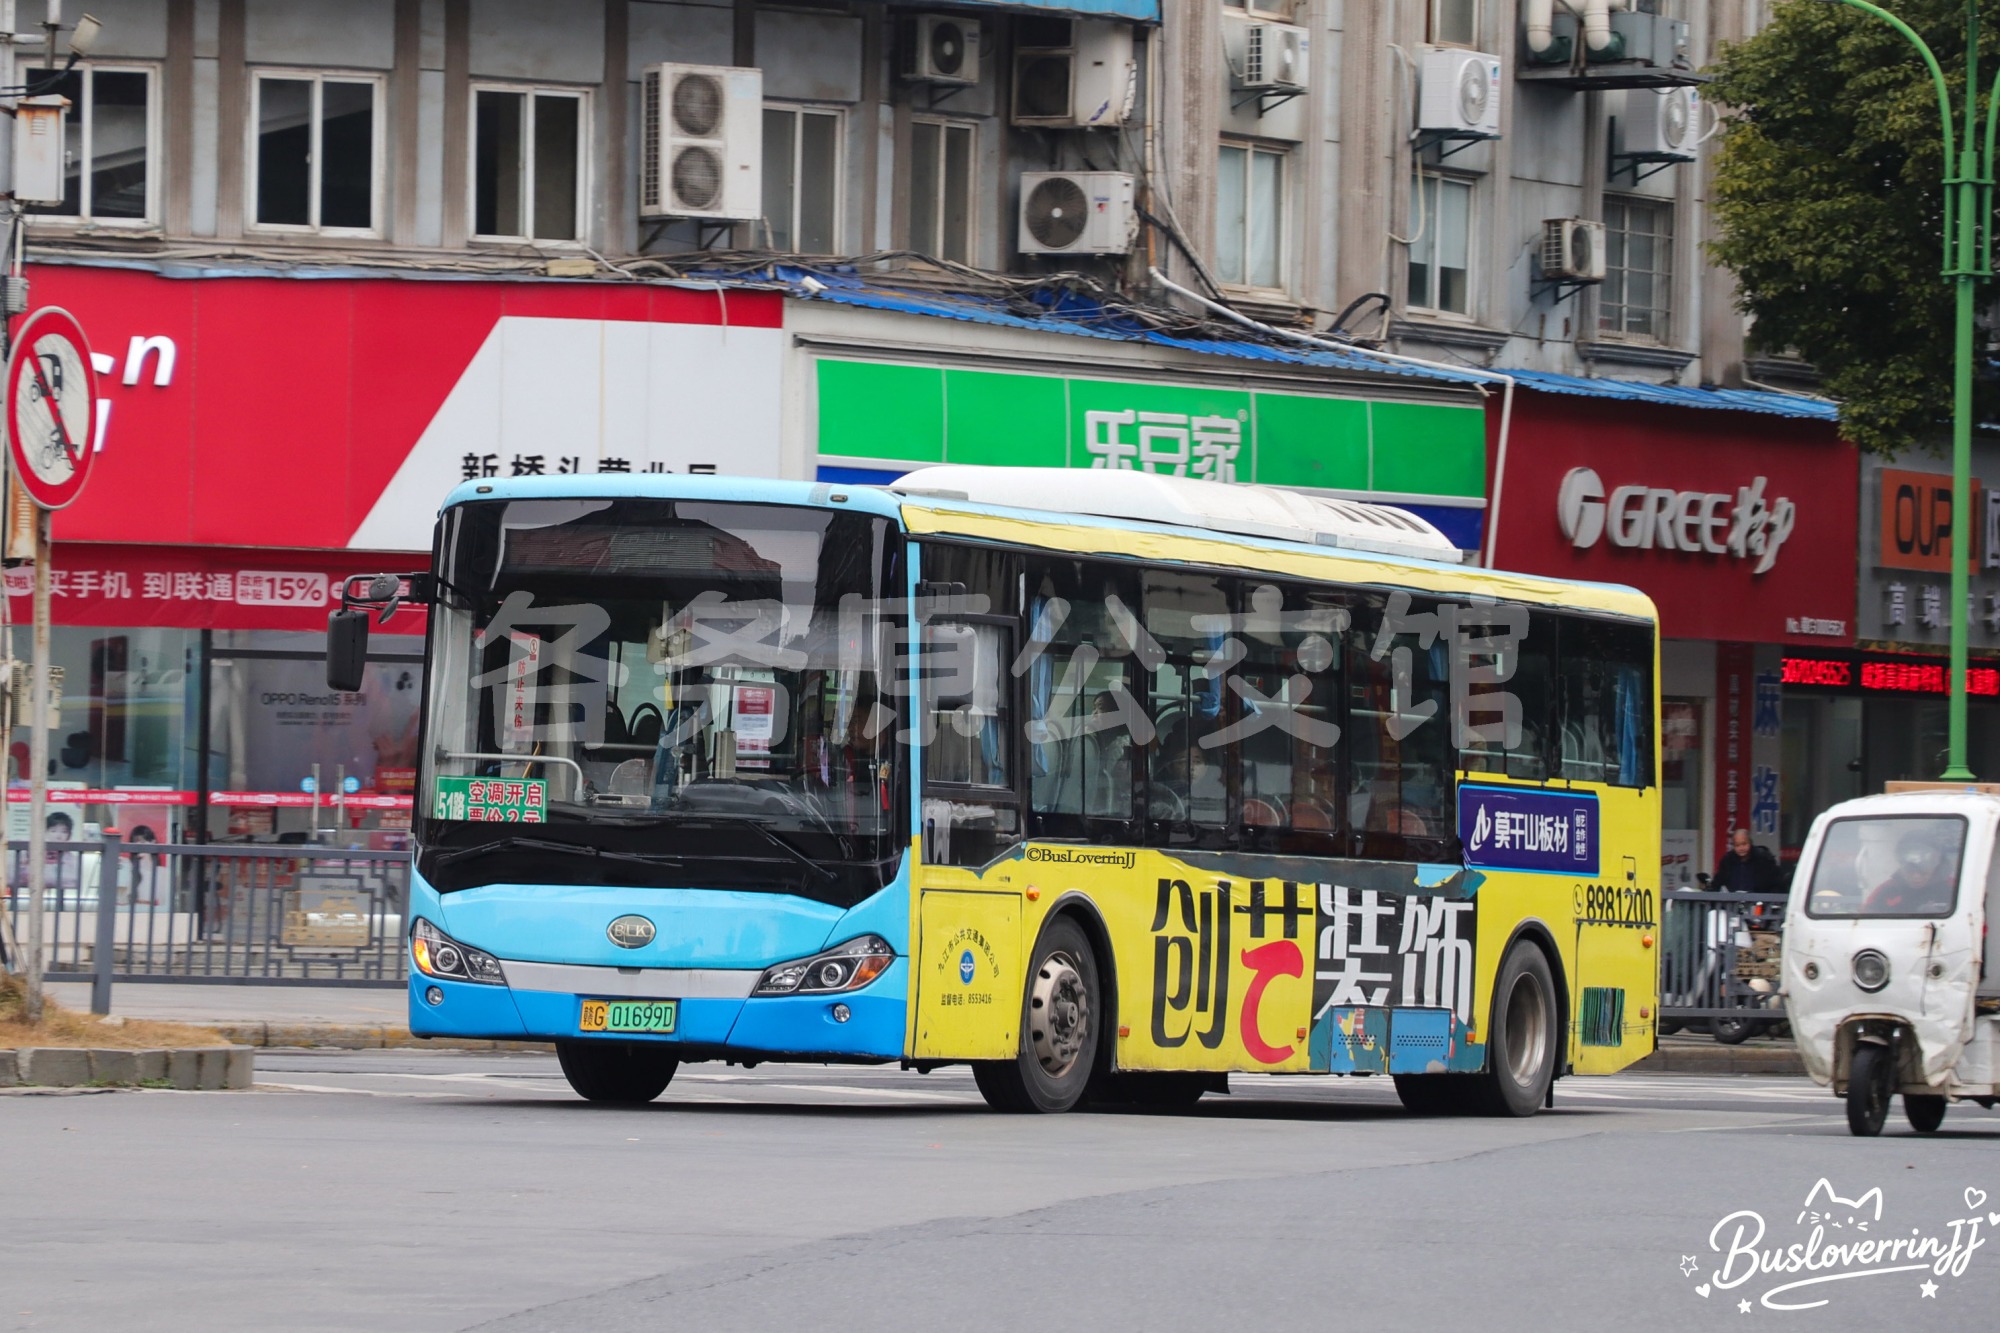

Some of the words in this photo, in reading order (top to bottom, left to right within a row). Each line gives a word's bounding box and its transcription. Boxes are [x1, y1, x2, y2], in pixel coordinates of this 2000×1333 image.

[1606, 485, 1732, 554] GREE
[1895, 484, 1978, 560] OUPI
[142, 572, 234, 601] 到联通
[266, 577, 323, 601] 15%
[261, 692, 296, 706] OPPO
[468, 782, 544, 807] 空调开启
[1494, 811, 1569, 853] 莫干山板材
[1586, 884, 1653, 930] 8981200
[968, 993, 992, 1004] 8553416
